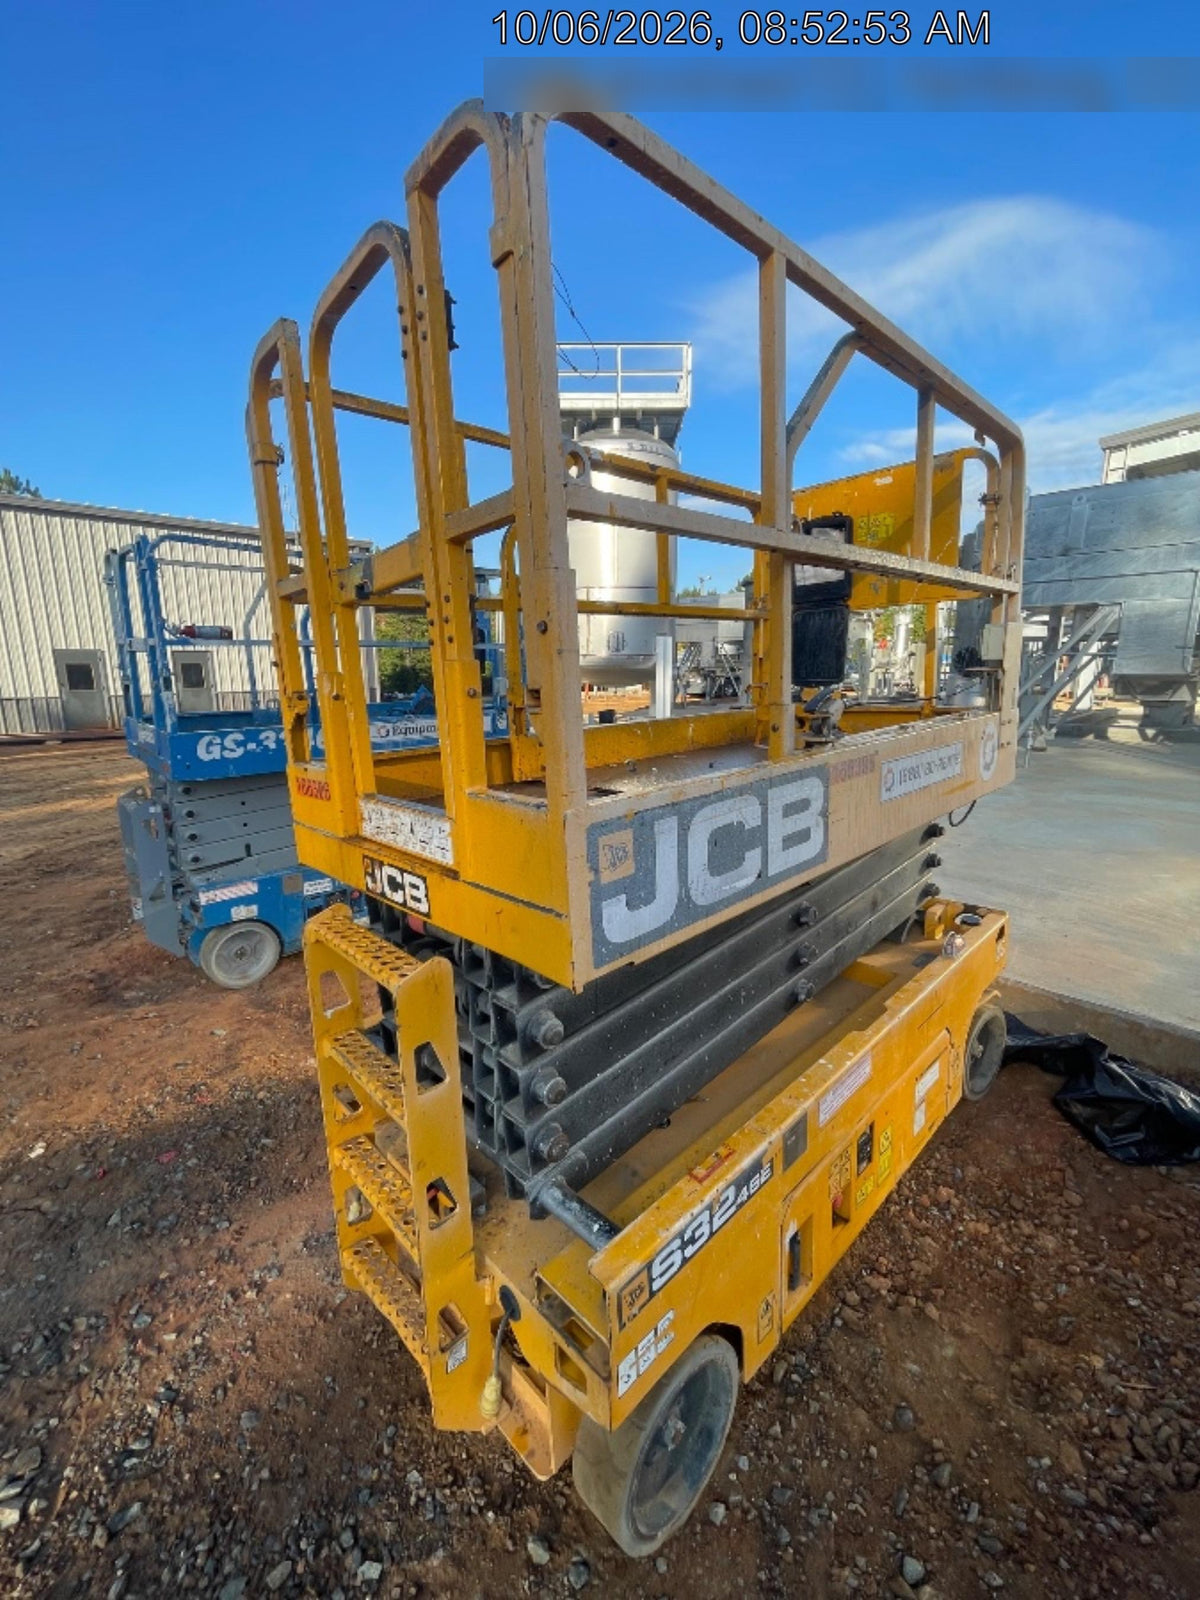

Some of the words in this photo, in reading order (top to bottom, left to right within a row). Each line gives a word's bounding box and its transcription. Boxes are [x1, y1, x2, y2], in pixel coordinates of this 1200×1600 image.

[392, 724, 437, 738] Equipm
[366, 857, 430, 915] JCB
[602, 776, 827, 944] JCB
